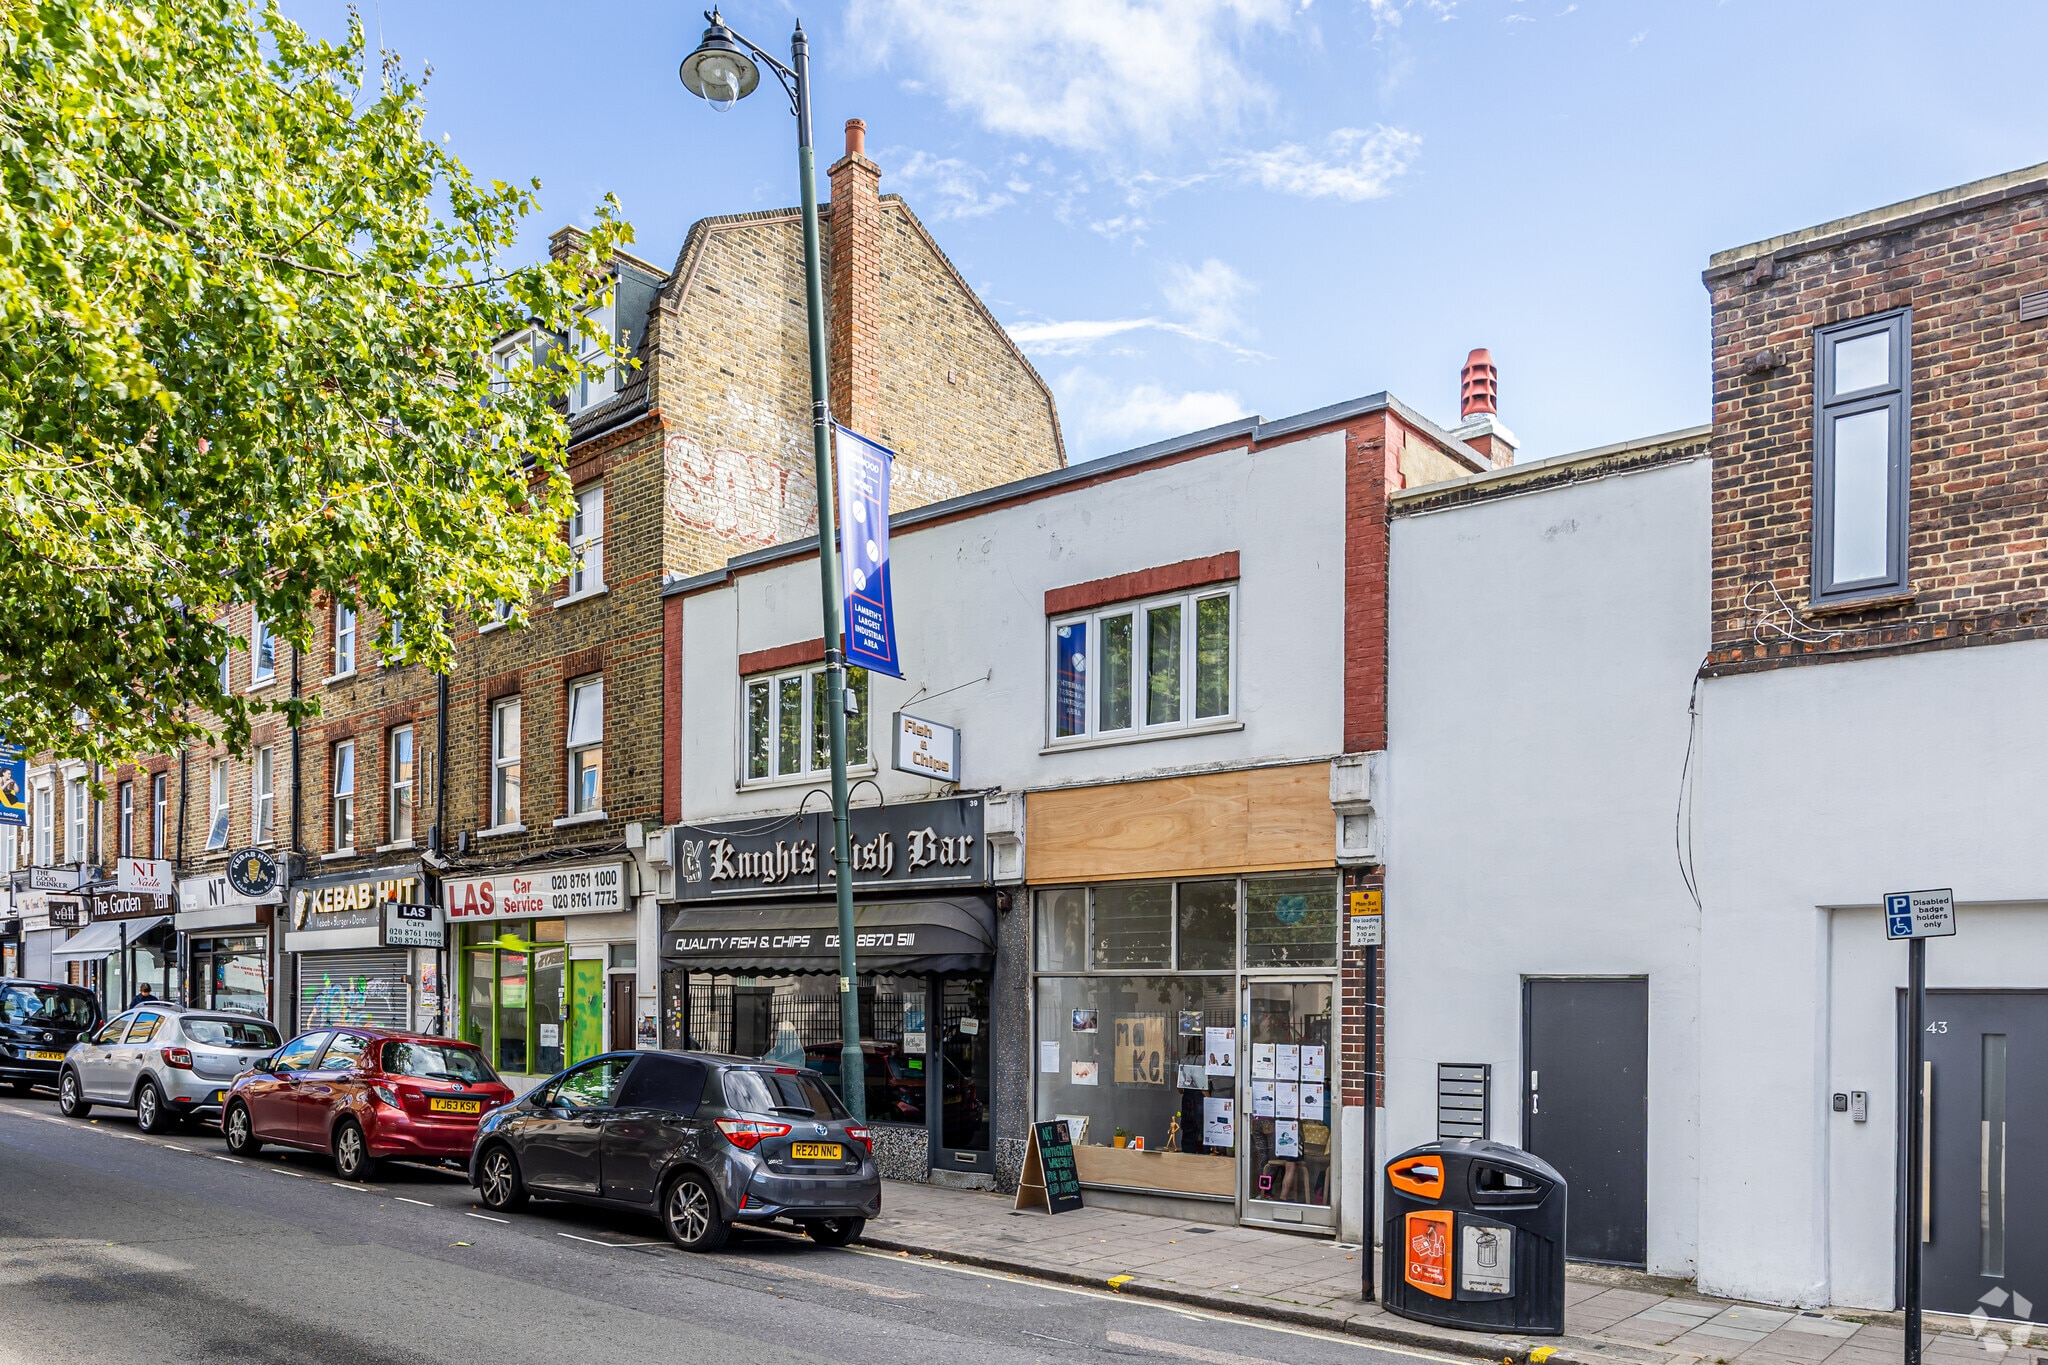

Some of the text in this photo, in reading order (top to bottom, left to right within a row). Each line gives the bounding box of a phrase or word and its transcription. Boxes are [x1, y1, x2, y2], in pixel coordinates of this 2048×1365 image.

[854, 603, 882, 622] LAMBETH'S
[858, 615, 880, 631] LARGEST
[855, 624, 885, 643] INDUSTRIAL
[864, 638, 878, 650] AREA
[904, 718, 933, 739] Fish
[920, 740, 928, 750] &
[912, 751, 949, 772] Chips
[828, 832, 895, 877] ish
[907, 826, 975, 873] Bar
[232, 851, 273, 869] KEBAB HUT
[132, 861, 157, 877] NT
[36, 881, 68, 889] DRINKER
[130, 877, 161, 887] Nails
[513, 878, 532, 895] Car
[551, 870, 617, 890] 020 8761 1000
[208, 878, 226, 906] NT
[311, 882, 374, 914] KEBAB
[448, 881, 495, 917] LAS
[552, 890, 618, 909] 020 8761 7775
[92, 896, 109, 916] The
[110, 892, 141, 914] Garden
[503, 895, 544, 914] Service
[1893, 898, 1907, 913] P
[1913, 898, 1949, 906] Disabled
[403, 906, 426, 918] LAS
[1918, 906, 1944, 914] badge
[333, 915, 349, 928] Burger
[406, 919, 425, 927] Cars
[389, 928, 442, 938] 020 8761 1000
[389, 936, 442, 946] 020 8761 7775
[675, 933, 915, 951] QUALITY FISH & CHIPS 02 8670 5111
[961, 1020, 978, 1028] CLOSED
[1926, 1021, 1948, 1034] 43
[435, 1099, 458, 1109] YJ63
[460, 1100, 477, 1111] KSK
[796, 1144, 838, 1157] RE20 NNC
[1424, 1271, 1443, 1281] recycling
